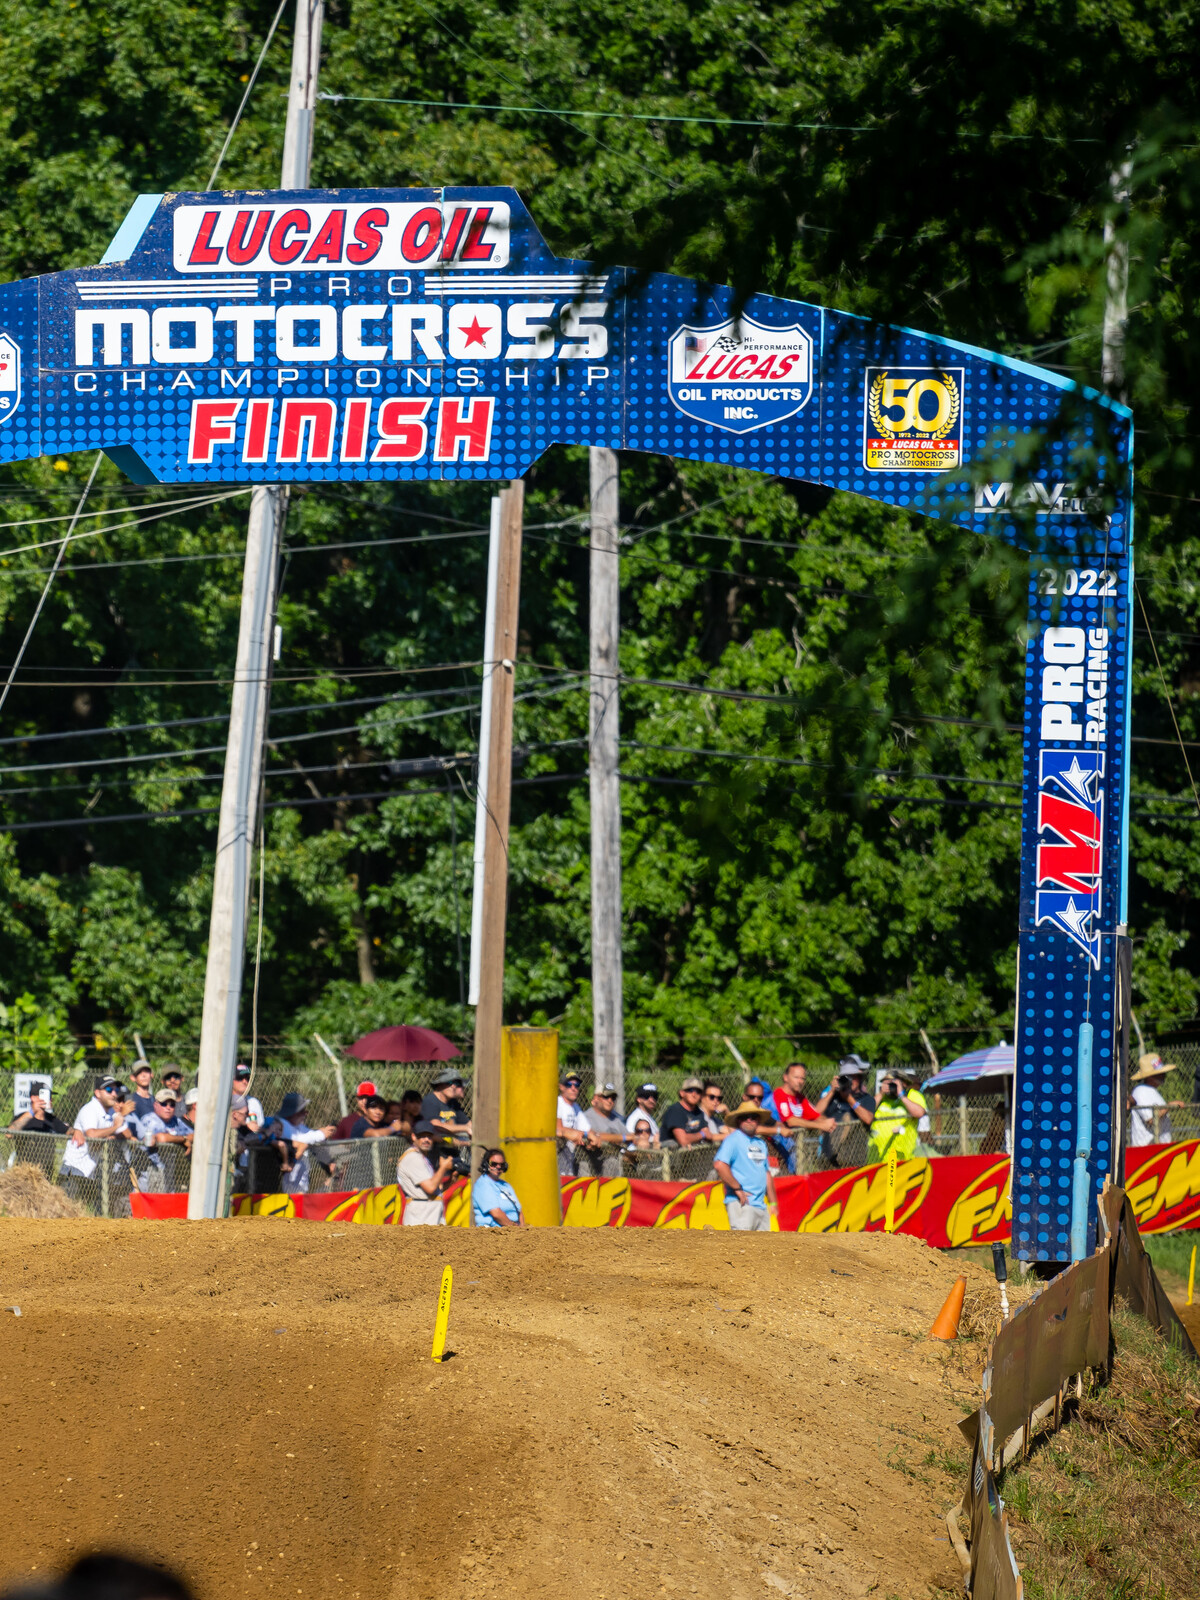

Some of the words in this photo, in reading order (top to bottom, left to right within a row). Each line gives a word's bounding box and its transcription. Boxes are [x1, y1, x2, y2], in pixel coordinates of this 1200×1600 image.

[187, 208, 390, 266] LUCAS
[400, 206, 494, 263] OIL
[270, 275, 413, 297] PRO
[75, 303, 609, 366] MOTOCROSS
[73, 366, 611, 390] CHAMPIONSHIP
[685, 354, 800, 380] LUCAS
[678, 388, 706, 401] OIL
[711, 388, 802, 401] PRODUCTS
[881, 378, 951, 433] 50
[724, 406, 758, 419] INC.
[187, 396, 495, 464] FINISH
[871, 451, 891, 459] PRO
[894, 451, 955, 459] MOTOCROSS
[892, 440, 920, 449] LUCAS
[920, 441, 935, 449] OIL
[974, 482, 1105, 507] MAV
[1038, 568, 1118, 597] 2022
[1040, 626, 1086, 741] PRO
[1085, 627, 1109, 742] RACING
[440, 1278, 449, 1312] ACERBIS
